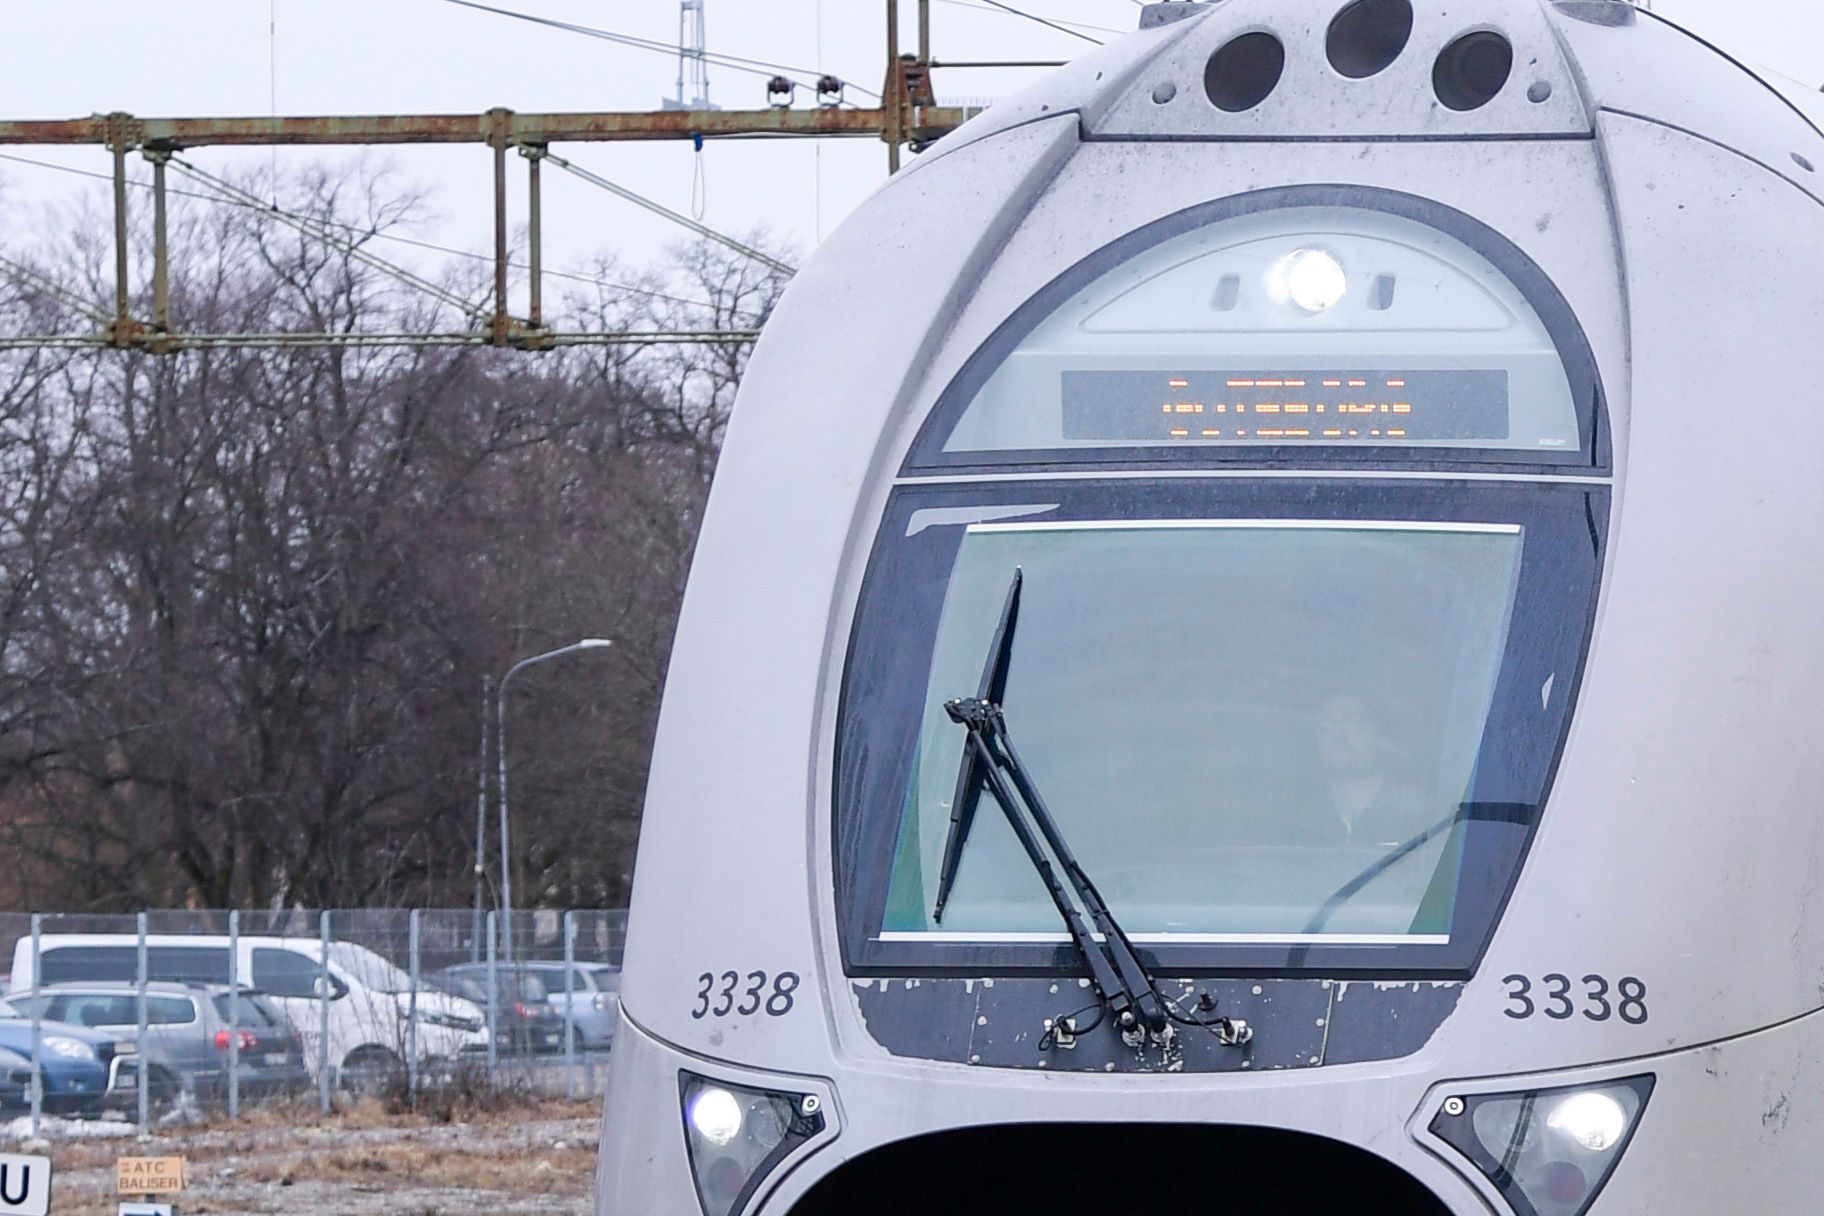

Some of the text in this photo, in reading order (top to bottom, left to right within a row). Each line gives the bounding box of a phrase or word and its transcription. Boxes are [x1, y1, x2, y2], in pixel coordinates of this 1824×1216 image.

[691, 970, 801, 1020] 3338
[1501, 973, 1649, 1025] 3338
[0, 1163, 31, 1206] U
[119, 1177, 178, 1189] BALISER
[133, 1162, 166, 1174] ATC
